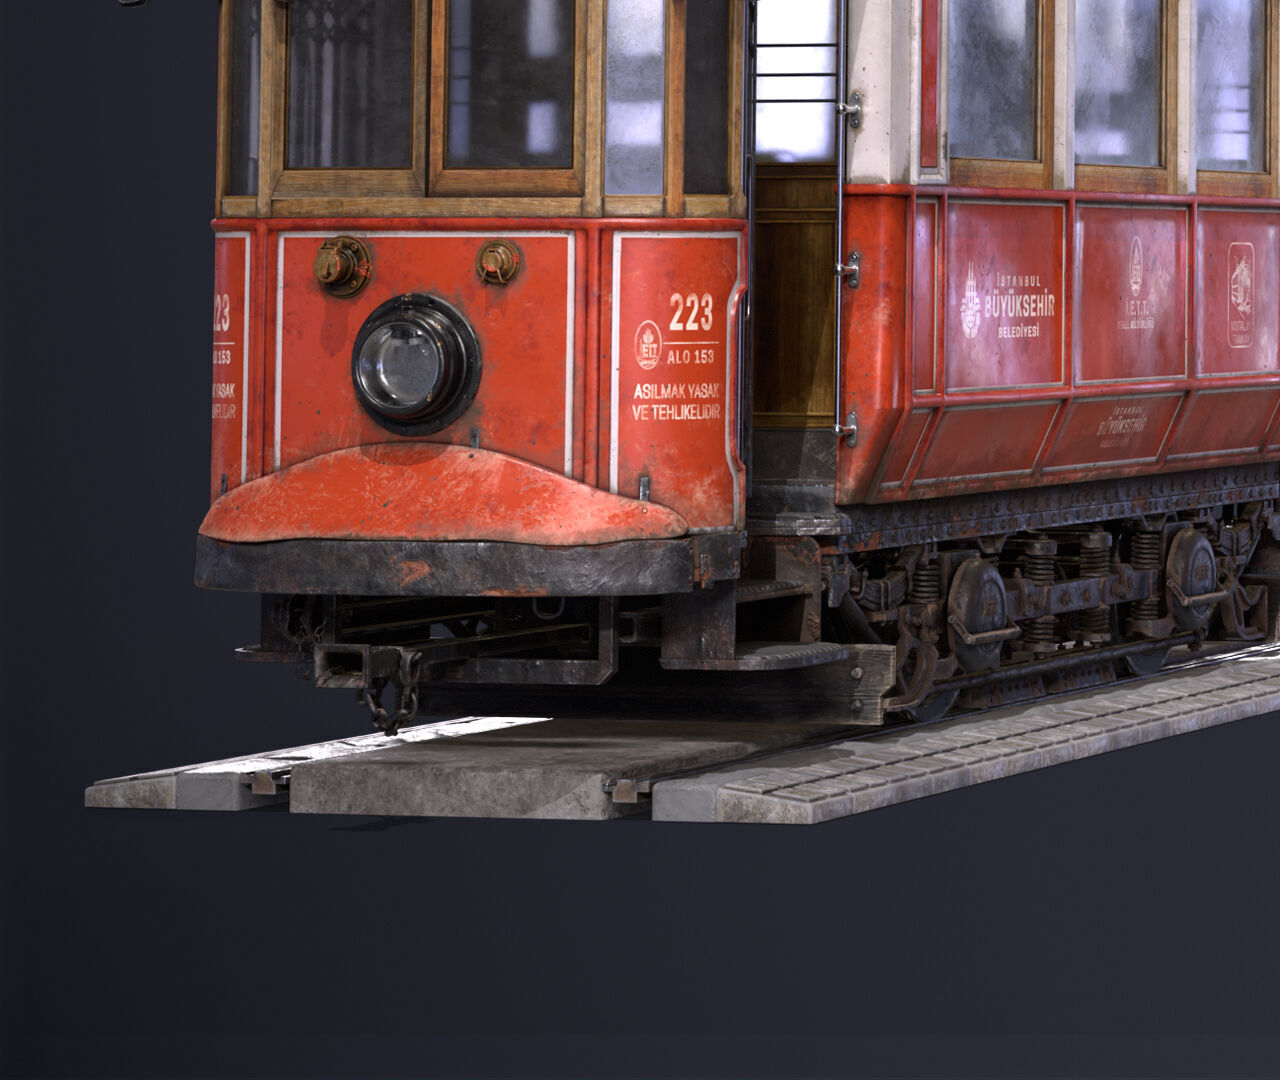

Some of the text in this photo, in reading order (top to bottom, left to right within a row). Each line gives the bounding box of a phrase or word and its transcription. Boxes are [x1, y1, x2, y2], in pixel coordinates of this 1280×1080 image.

[997, 271, 1041, 287] İSTANBUL
[213, 293, 230, 332] 23
[669, 293, 713, 331] 223
[998, 322, 1040, 339] BELEDİYESİ
[666, 349, 715, 365] ALO 153
[633, 382, 720, 399] ASILMAK YASAK
[632, 405, 649, 421] VE
